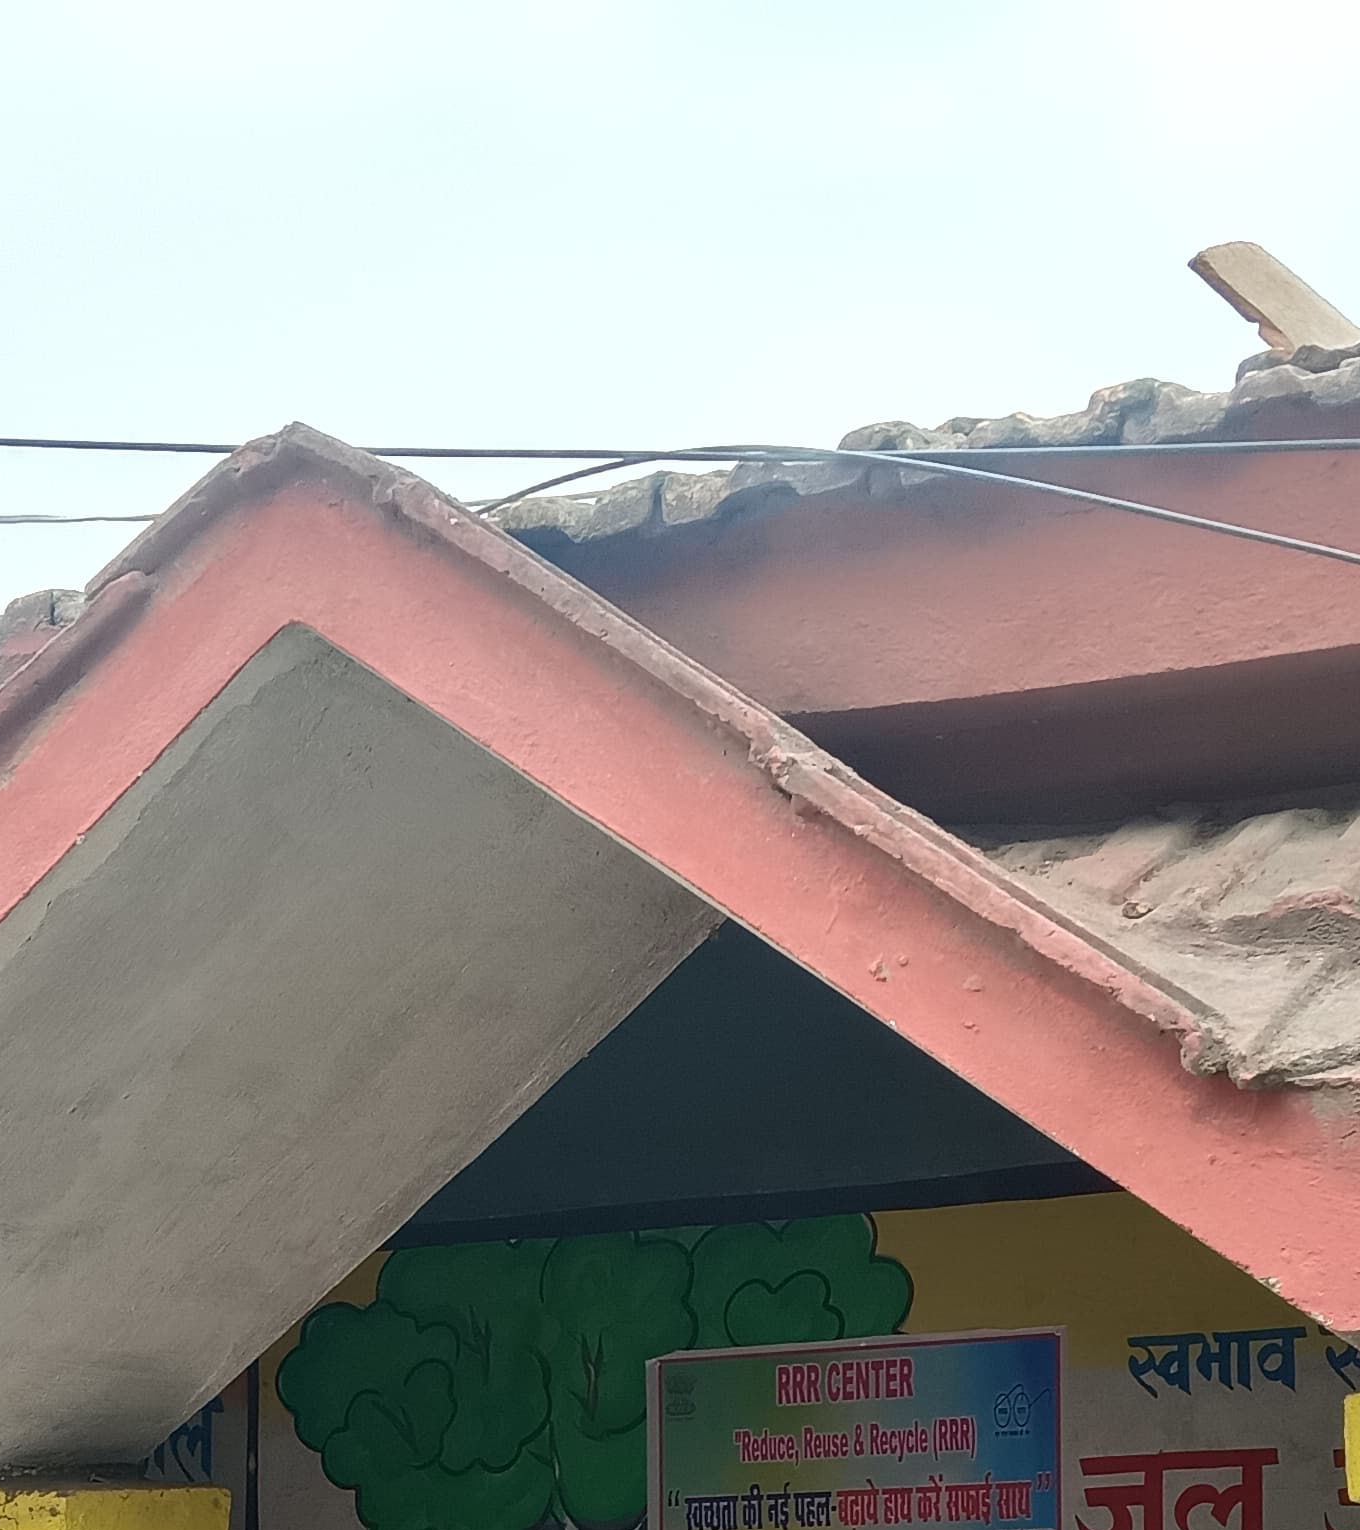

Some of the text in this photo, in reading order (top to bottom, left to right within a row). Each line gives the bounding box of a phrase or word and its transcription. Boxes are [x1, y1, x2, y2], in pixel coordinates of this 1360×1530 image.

[776, 1357, 915, 1405] RRR CENTER
[1128, 1326, 1306, 1398] स्वभाव
[803, 1427, 849, 1459] Reuse
[854, 1424, 865, 1456] &
[870, 1420, 929, 1463] Recycle
[933, 1416, 976, 1461] (RRR)
[741, 1484, 764, 1530] की
